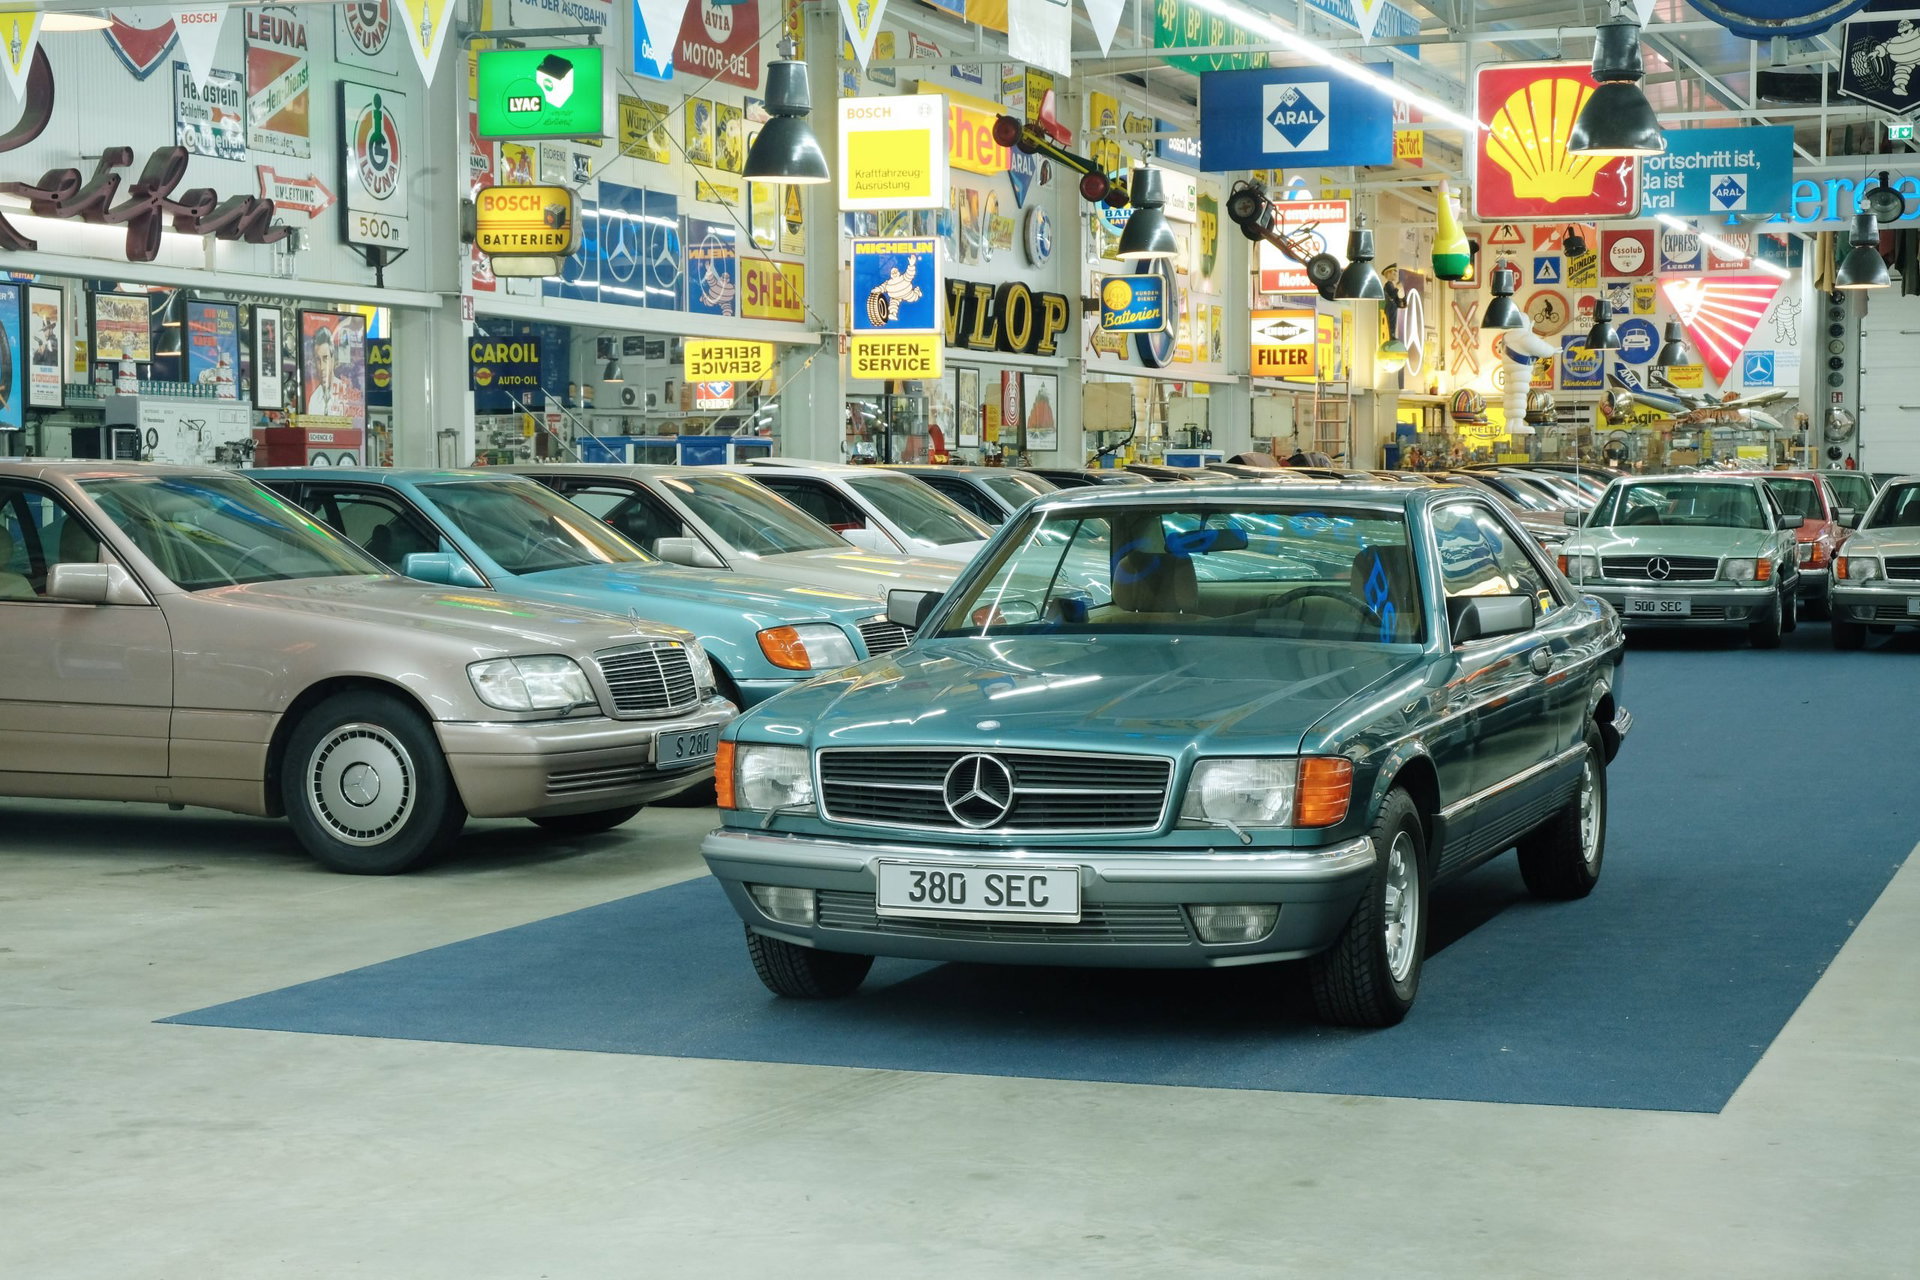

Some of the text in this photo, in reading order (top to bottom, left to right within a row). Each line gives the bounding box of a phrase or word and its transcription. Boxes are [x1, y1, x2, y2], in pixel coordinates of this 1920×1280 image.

[181, 12, 218, 25] BOSCH
[541, 0, 560, 12] DER
[561, 3, 608, 27] AUTOBAHN
[704, 10, 731, 32] AVIA
[246, 11, 309, 52] LEUNA
[346, 13, 388, 49] LEUNA
[1187, 7, 1201, 40] BP
[1211, 17, 1224, 47] BP
[681, 39, 751, 79] MOTOR-OEL
[182, 73, 239, 108] Hebstein
[509, 97, 541, 112] LYAC
[847, 107, 892, 119] BOSCH
[1273, 109, 1319, 126] ARAL
[949, 106, 1010, 173] hell
[470, 159, 489, 169] ANOL
[1011, 152, 1033, 176] ARAL
[1734, 149, 1761, 170] ist,
[360, 159, 398, 195] LEUNA
[855, 181, 911, 191] Ausrüstung
[1664, 172, 1685, 189] ist
[1642, 191, 1675, 209] Aral
[1715, 188, 1742, 197] ARAL
[484, 195, 541, 211] BOSCH
[359, 216, 391, 239] 500
[483, 233, 563, 246] BATTERIEN
[854, 241, 935, 256] MICHELIN
[1664, 233, 1699, 253] EXPRESS
[1612, 246, 1643, 255] Essolub
[1567, 254, 1598, 276] DUNLOP
[747, 269, 801, 310] SHELL
[1102, 306, 1161, 328] Batterien
[470, 342, 539, 363] CAROIL
[857, 343, 930, 356] REIFEN-
[1257, 348, 1308, 366] FILTER
[857, 358, 931, 371] SERVICE
[497, 375, 538, 385] AUTO-OIL
[1617, 367, 1637, 388] ANA
[1628, 411, 1662, 425] Agip
[1634, 600, 1682, 612] 500 SEC
[676, 732, 710, 758] S 280
[908, 870, 1049, 908] 380 SEC
